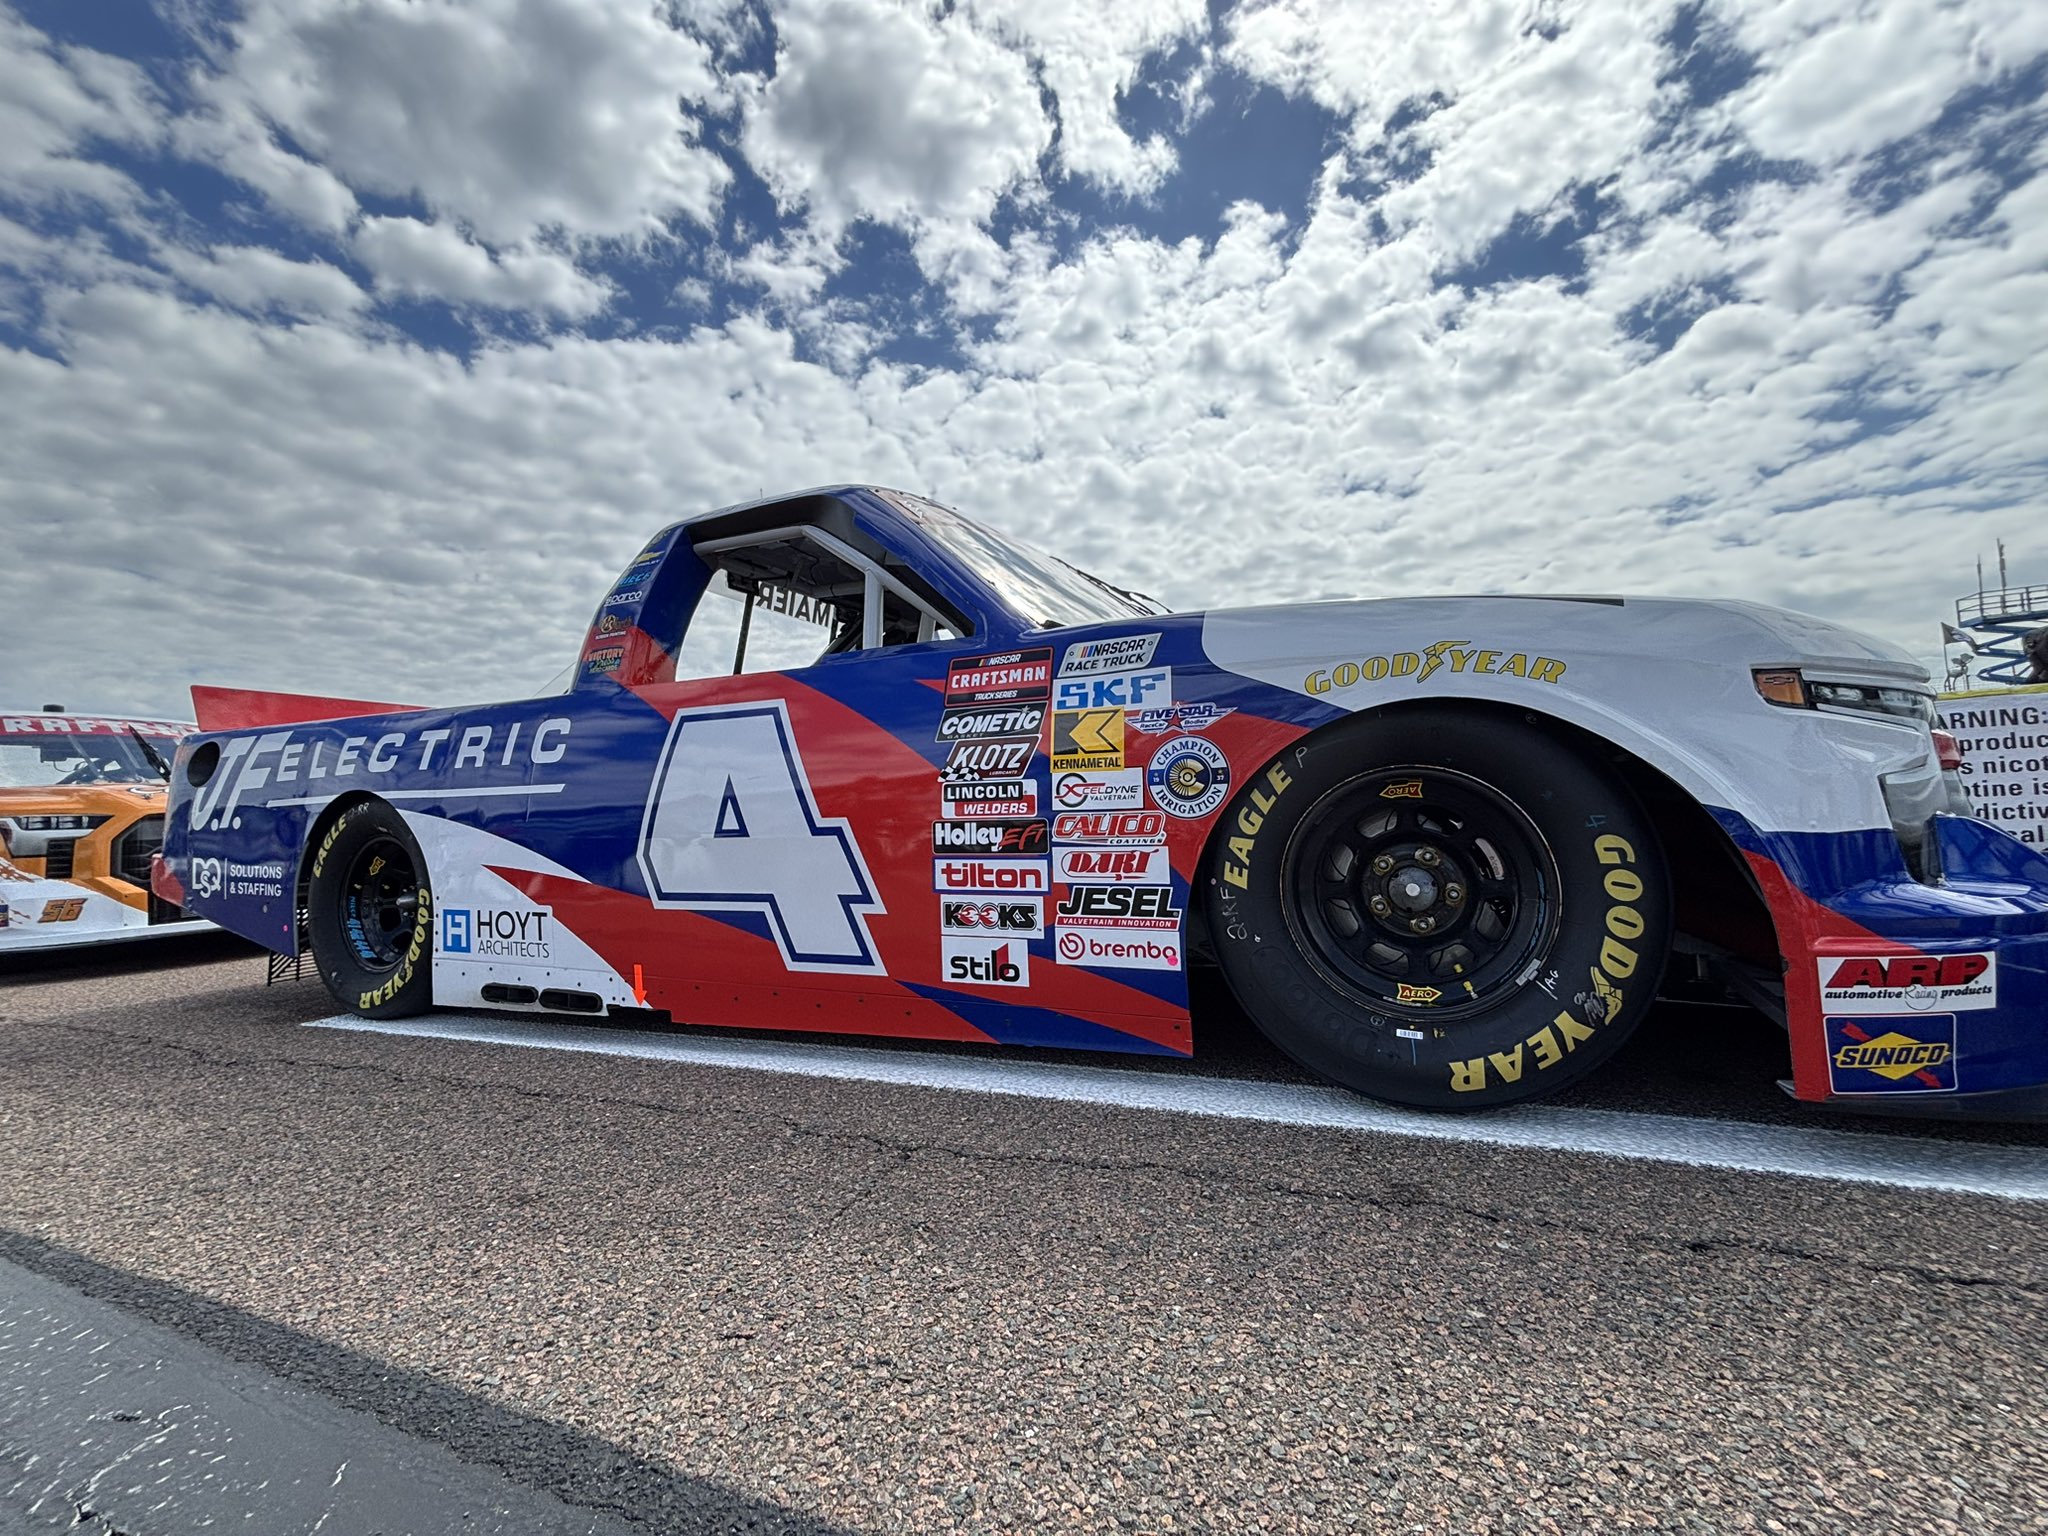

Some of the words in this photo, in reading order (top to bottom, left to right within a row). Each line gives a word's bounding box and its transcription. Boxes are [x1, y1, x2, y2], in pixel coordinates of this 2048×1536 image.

[988, 654, 1021, 666] NASCAR
[1092, 639, 1146, 657] NASCAR
[1065, 659, 1100, 672] RACE
[1103, 652, 1146, 668] TRUCK
[1304, 647, 1567, 695] GOODYEAR
[951, 666, 1046, 689] CRAFTSMAN
[974, 691, 994, 701] TRUCK
[994, 690, 1018, 699] SERIES
[1056, 673, 1166, 710] SKF
[941, 710, 1042, 735] COMETIC
[1141, 708, 1176, 721] FIVE
[1179, 705, 1214, 718] STAR
[276, 718, 572, 783] ELECTRIC
[952, 743, 1031, 770] KLOTZ
[1156, 740, 1220, 766] CHAMPION
[1053, 757, 1121, 770] KENNAMETAL
[946, 785, 1019, 799] LINCOLN
[1055, 783, 1138, 798] XCELDYNE
[1156, 786, 1222, 815] IRRIGATION
[1388, 786, 1417, 796] AERO
[964, 803, 1028, 815] WELDERS
[934, 822, 1003, 852] Holley
[1054, 814, 1161, 838] CALICO
[1224, 760, 1293, 890] EAGLE
[314, 813, 347, 879] EAGLE
[636, 699, 888, 976] 4
[230, 864, 282, 880] SOLUTIONS
[1067, 849, 1159, 874] DART
[941, 863, 1042, 889] tilton
[229, 881, 236, 894] &
[237, 882, 282, 897] STAFFING
[37, 898, 88, 924] 56
[1058, 887, 1180, 918] JESEL
[477, 909, 548, 941] HOYT
[943, 902, 1037, 930] KOOKS
[1063, 917, 1113, 926] VALVETRAIN
[1118, 919, 1172, 928] INNOVATION
[478, 940, 550, 958] ARCHITECTS
[1090, 938, 1178, 960] brembo
[950, 945, 1020, 982] Stilo
[1825, 954, 1990, 988] ARP
[1402, 988, 1432, 998] AERO
[1824, 989, 1903, 999] automotive
[1940, 985, 1993, 999] products
[1840, 1045, 1947, 1066] SUNOCO
